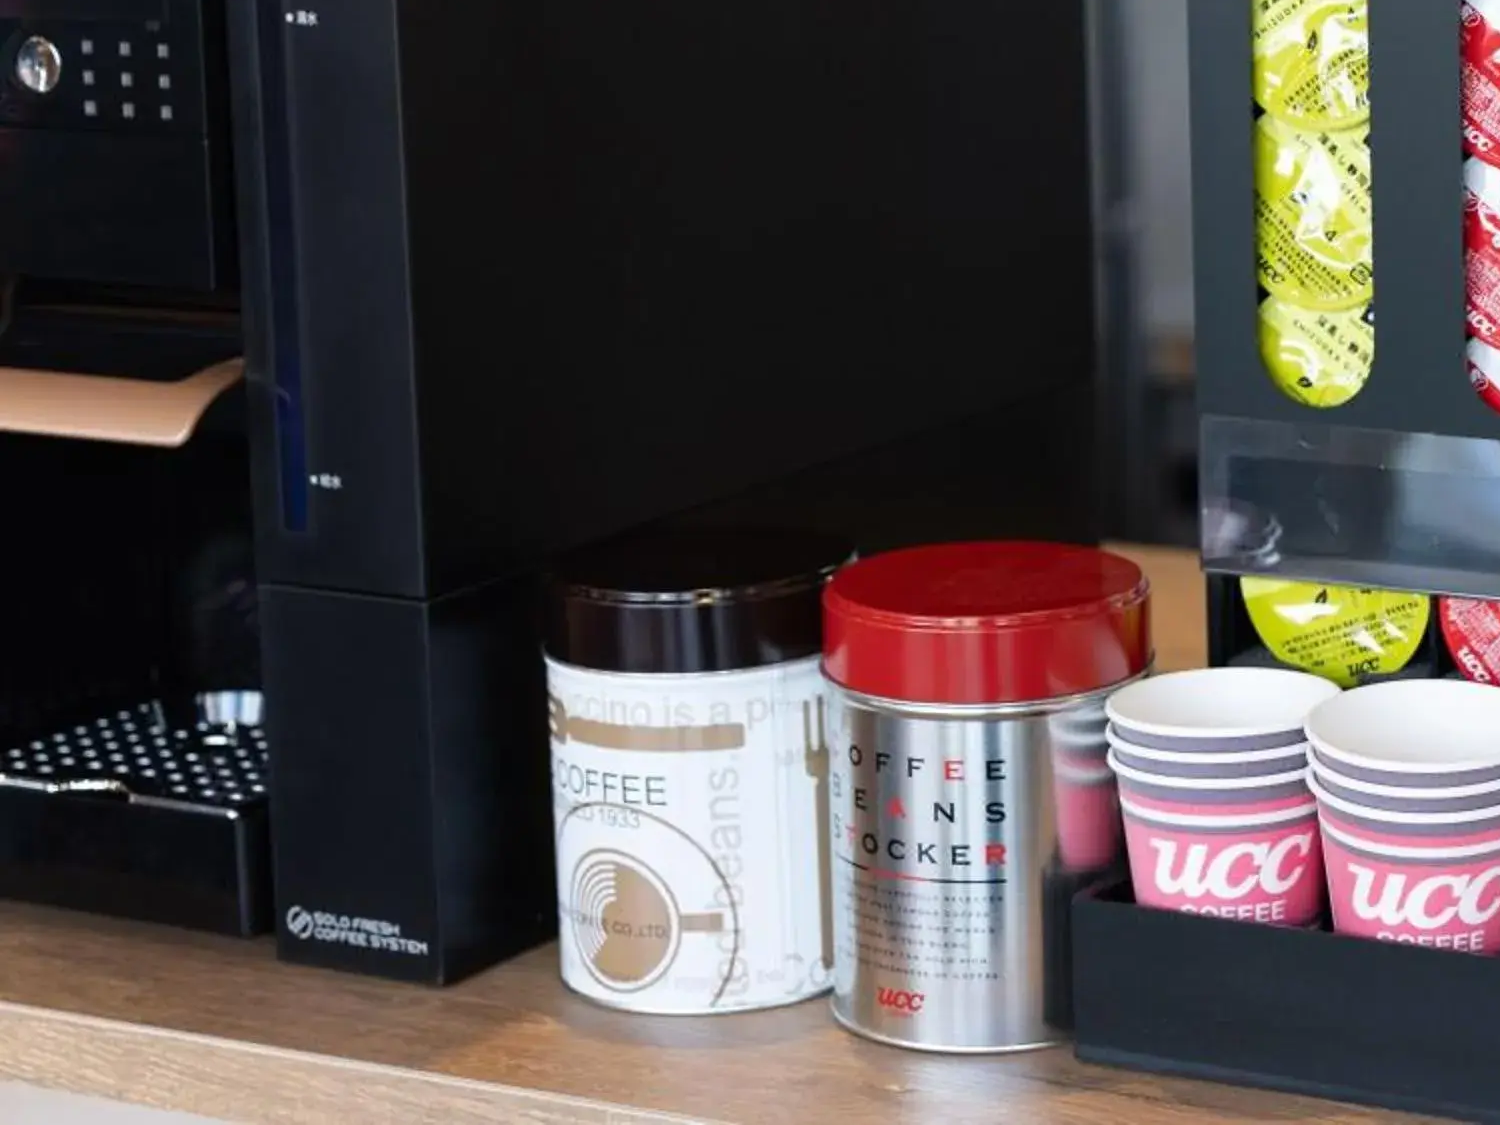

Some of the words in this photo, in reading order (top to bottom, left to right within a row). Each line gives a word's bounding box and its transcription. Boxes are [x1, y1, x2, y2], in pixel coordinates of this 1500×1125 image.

[557, 758, 668, 806] COFFEE
[1150, 833, 1311, 900] UCC
[313, 927, 367, 946] COFFEE
[369, 935, 428, 955] SYSTEM
